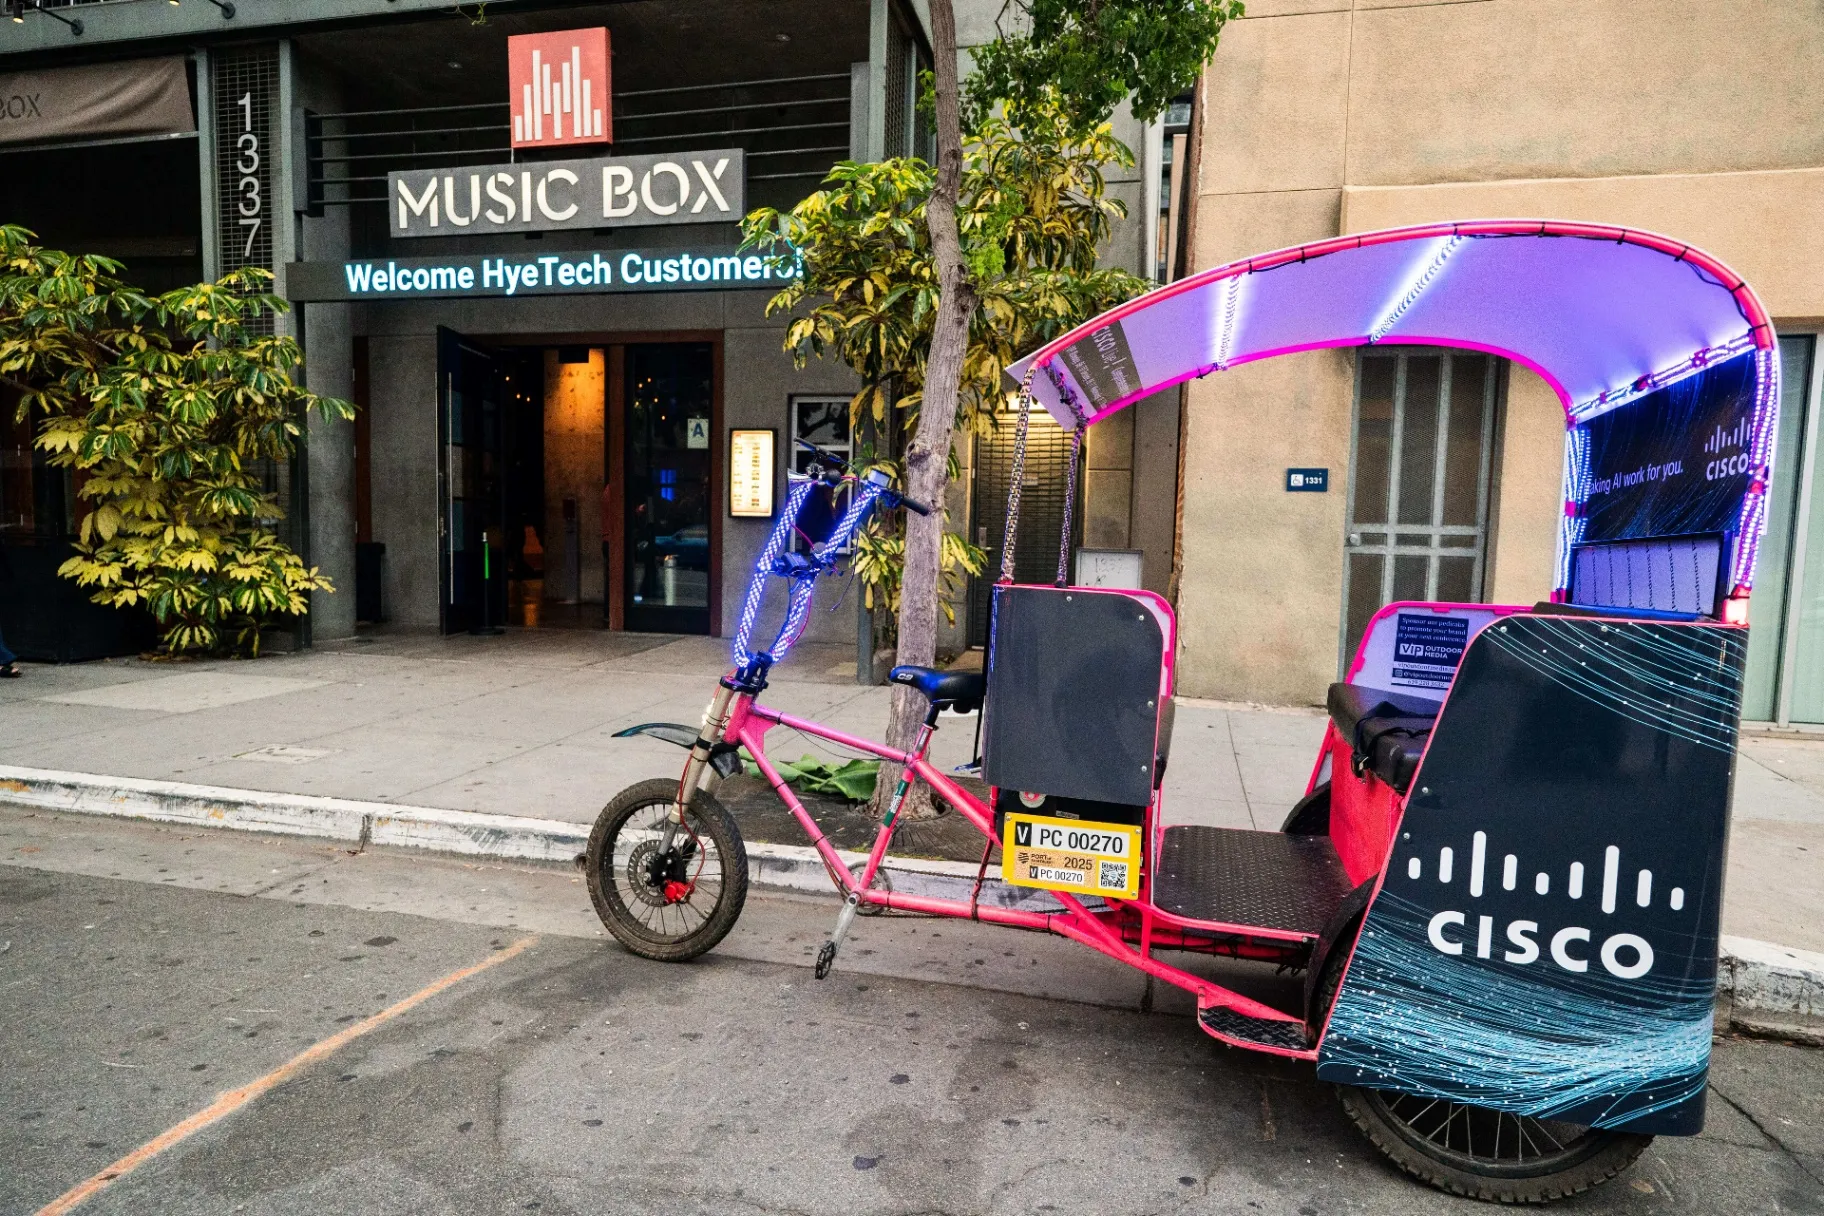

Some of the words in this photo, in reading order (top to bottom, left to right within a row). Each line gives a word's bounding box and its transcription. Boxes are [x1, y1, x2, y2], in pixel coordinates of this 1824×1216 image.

[237, 92, 261, 257] 1337
[397, 168, 580, 229] MUSIC
[602, 158, 731, 219] BOX
[345, 262, 475, 293] Welcome
[483, 254, 612, 295] HyeTech
[692, 423, 705, 438] A
[1304, 476, 1323, 485] 1331
[1588, 478, 1611, 494] aking
[1612, 472, 1622, 489] AI
[1623, 466, 1645, 487] work
[1646, 463, 1661, 481] for
[1662, 460, 1684, 482] you.
[1706, 452, 1749, 481] CISCO
[1424, 651, 1448, 659] MEDIA
[1425, 645, 1463, 655] OUTDOOR
[1016, 825, 1029, 844] V
[1040, 828, 1063, 847] PC
[1068, 831, 1123, 854] 00270
[1030, 853, 1047, 861] PORT
[1064, 856, 1093, 871] 2025
[1030, 866, 1038, 878] V
[1040, 868, 1053, 879] PC
[1054, 870, 1083, 883] 00270
[1427, 910, 1654, 979] CISCO
